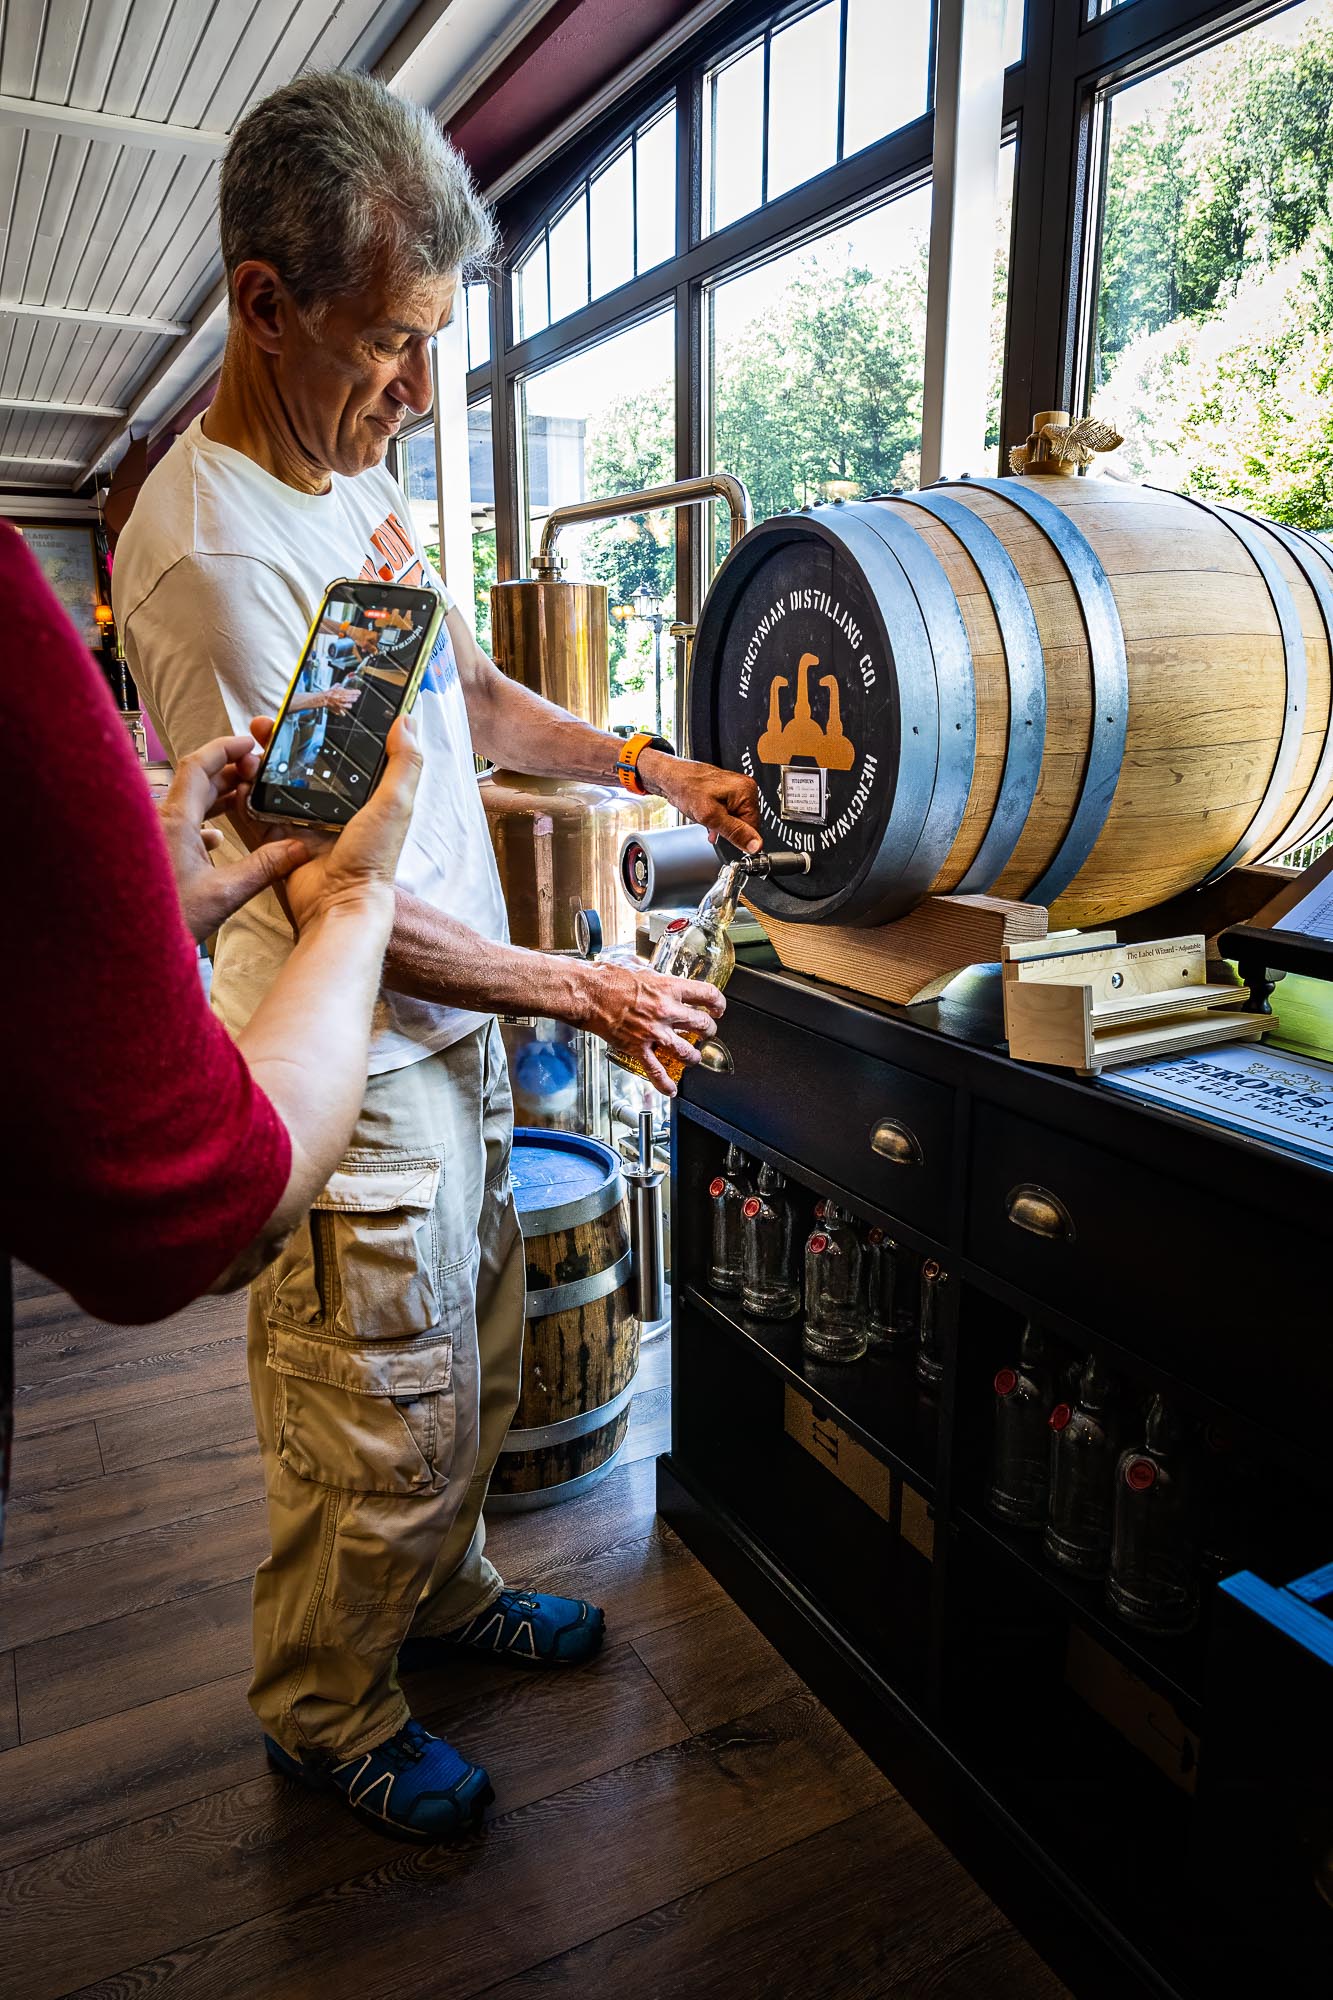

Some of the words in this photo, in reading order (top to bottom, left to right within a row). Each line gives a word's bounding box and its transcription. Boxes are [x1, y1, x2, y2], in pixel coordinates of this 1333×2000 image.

[738, 598, 786, 699] HERCYNIAN
[789, 588, 863, 650] DISTILLING
[859, 654, 876, 694] CO.
[820, 753, 878, 850] HERCYNIAN
[1127, 952, 1138, 960] The
[1139, 949, 1154, 958] Label
[1155, 946, 1175, 955] Wizard
[1194, 1085, 1250, 1102] MALT
